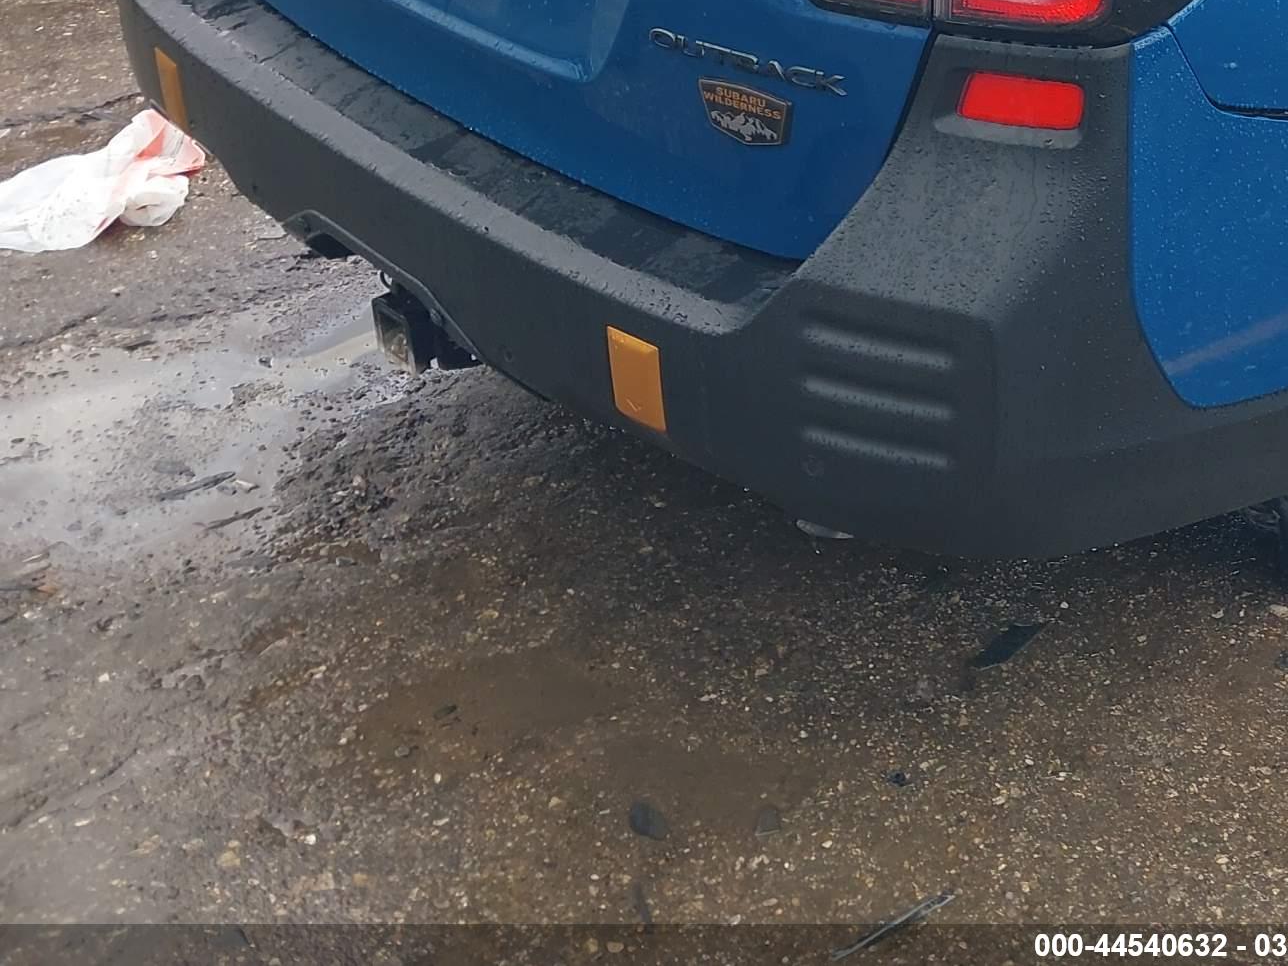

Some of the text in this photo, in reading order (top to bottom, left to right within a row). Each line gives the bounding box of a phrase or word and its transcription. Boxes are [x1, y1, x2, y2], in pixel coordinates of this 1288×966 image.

[649, 27, 848, 96] OUTBACK
[703, 90, 782, 120] WILDERNESS
[715, 86, 767, 108] SUBARU
